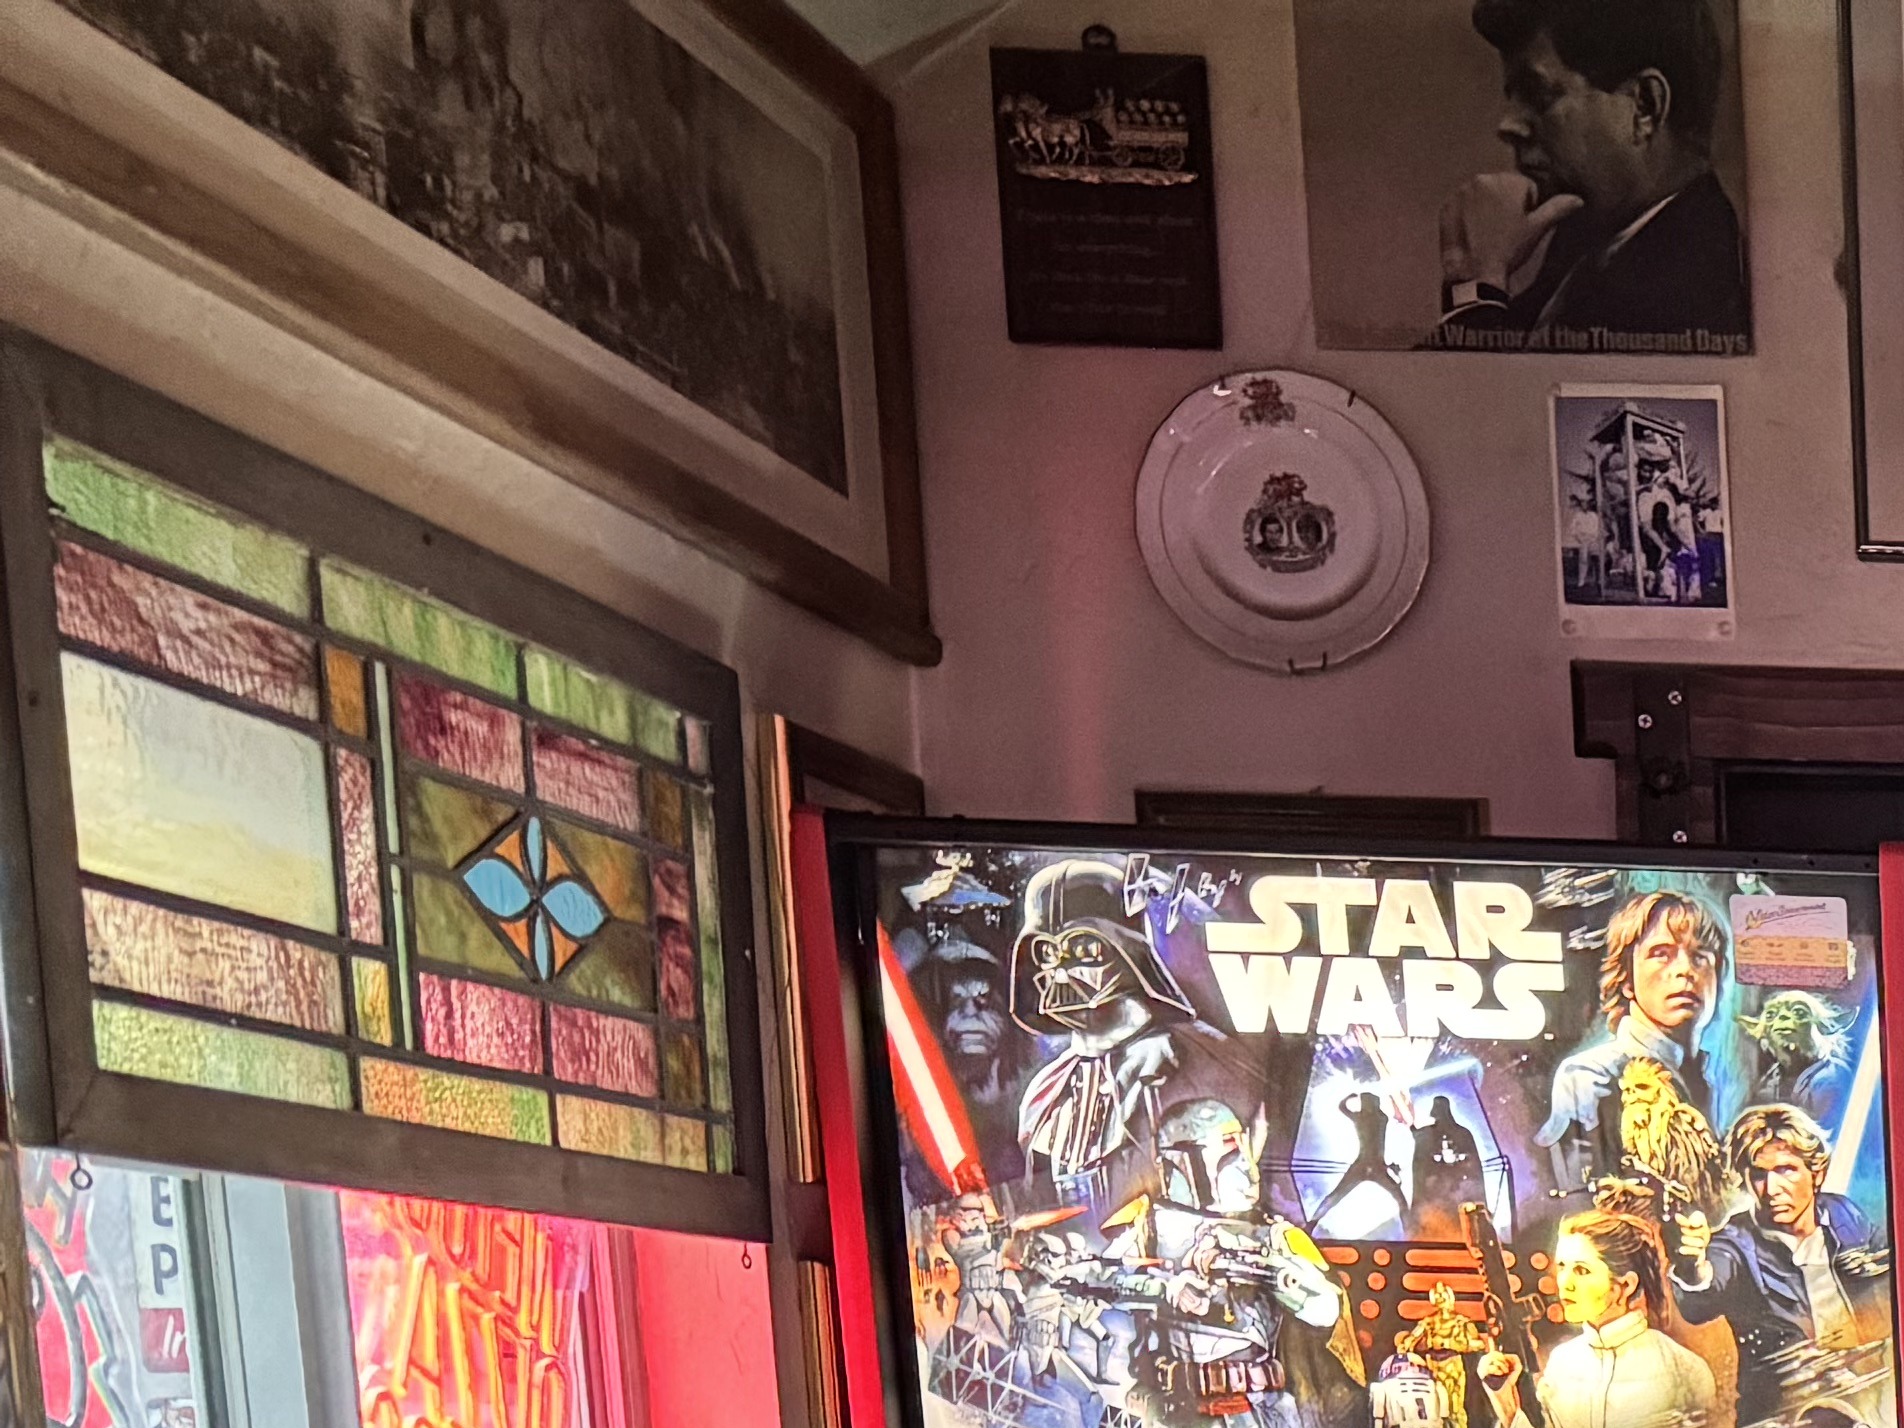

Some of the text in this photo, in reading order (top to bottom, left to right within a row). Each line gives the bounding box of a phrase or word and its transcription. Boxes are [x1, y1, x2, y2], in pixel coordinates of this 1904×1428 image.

[1444, 325, 1524, 349] Warrior
[1555, 327, 1590, 349] the
[1591, 327, 1690, 351] Thousand
[1697, 329, 1747, 353] Days
[1205, 875, 1564, 962] STAR
[1212, 954, 1566, 1040] WARS
